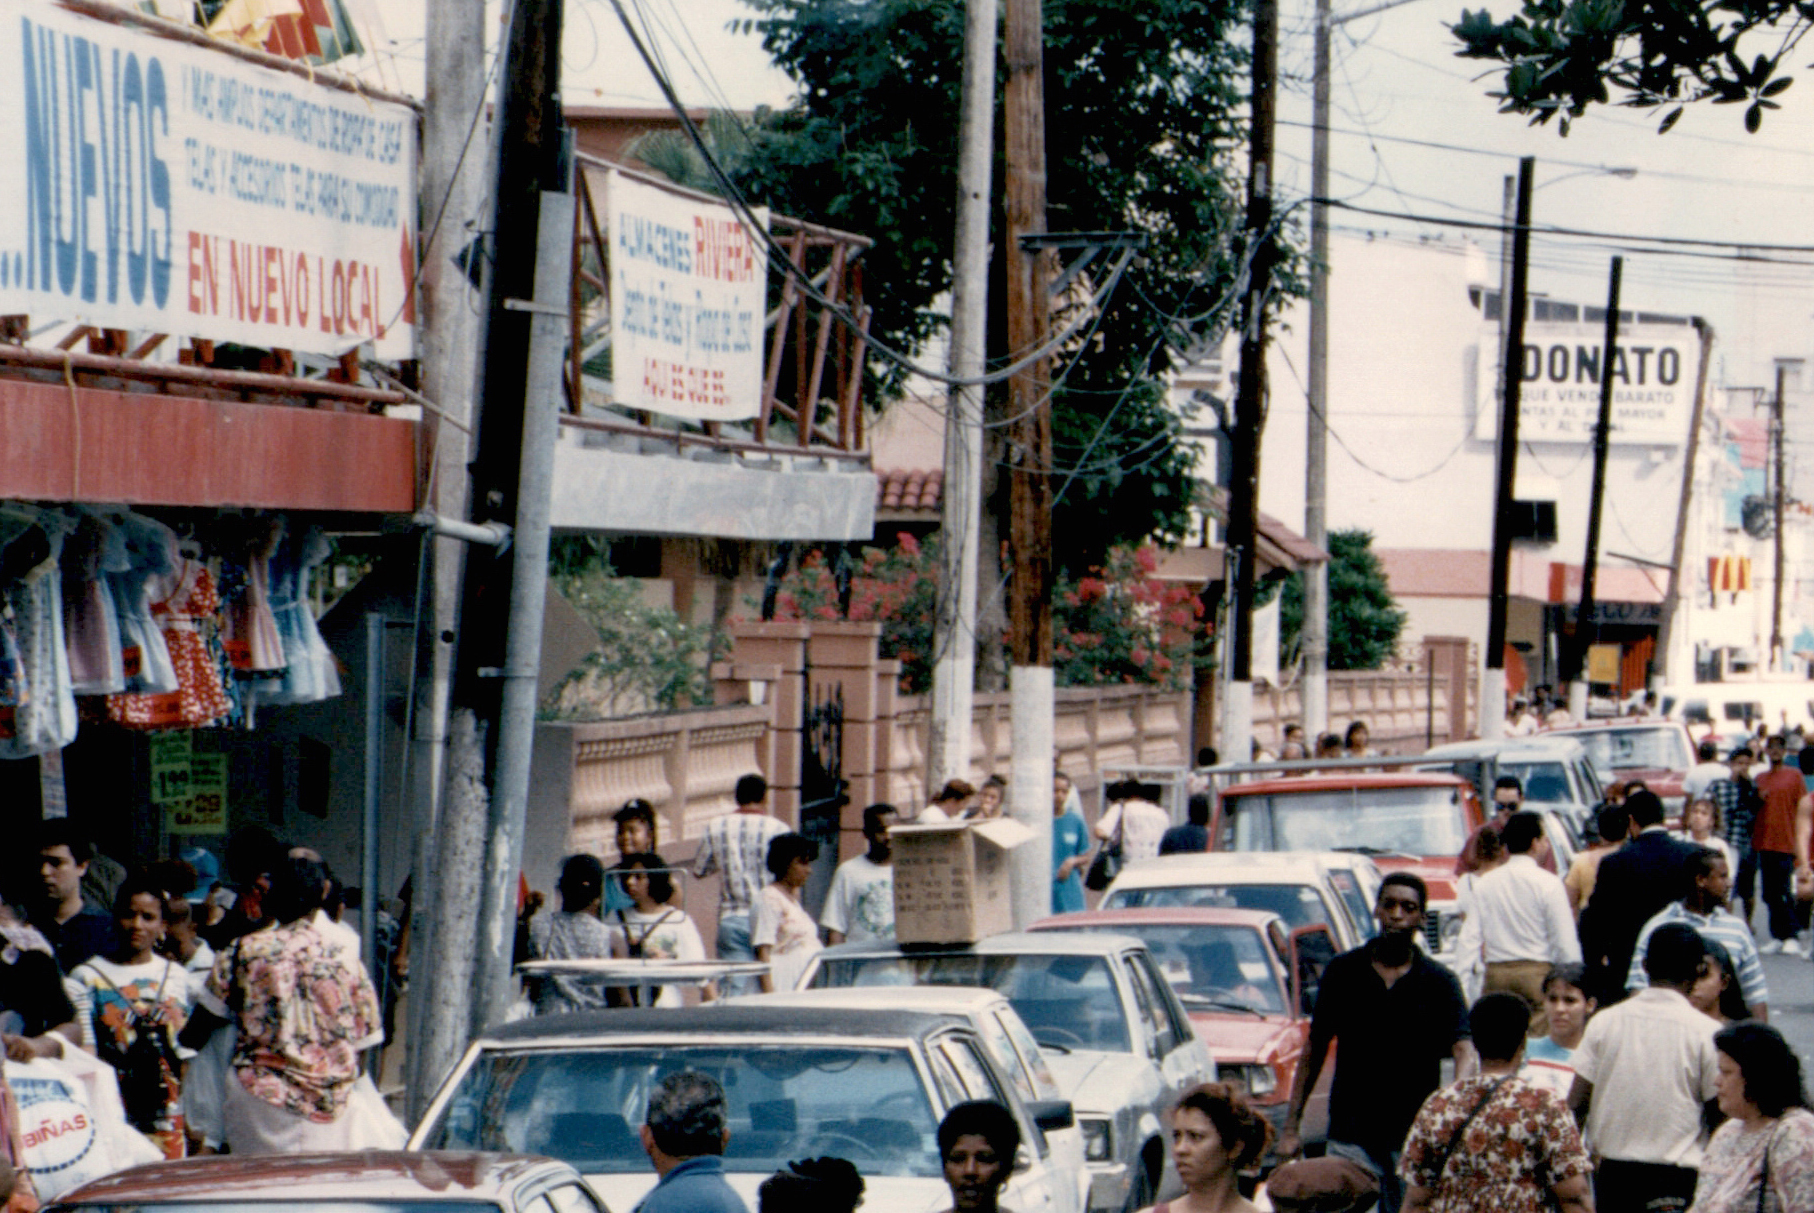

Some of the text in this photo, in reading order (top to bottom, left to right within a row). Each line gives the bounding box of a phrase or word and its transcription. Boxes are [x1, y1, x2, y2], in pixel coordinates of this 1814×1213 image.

[217, 76, 255, 131] AMPLIOS
[184, 136, 216, 195] TELAS
[619, 212, 754, 283] ALMACENES RIVIERA
[188, 229, 386, 341] EN NUEVO LOCAL
[1556, 390, 1605, 402] VEND
[1615, 392, 1676, 404] BARATO
